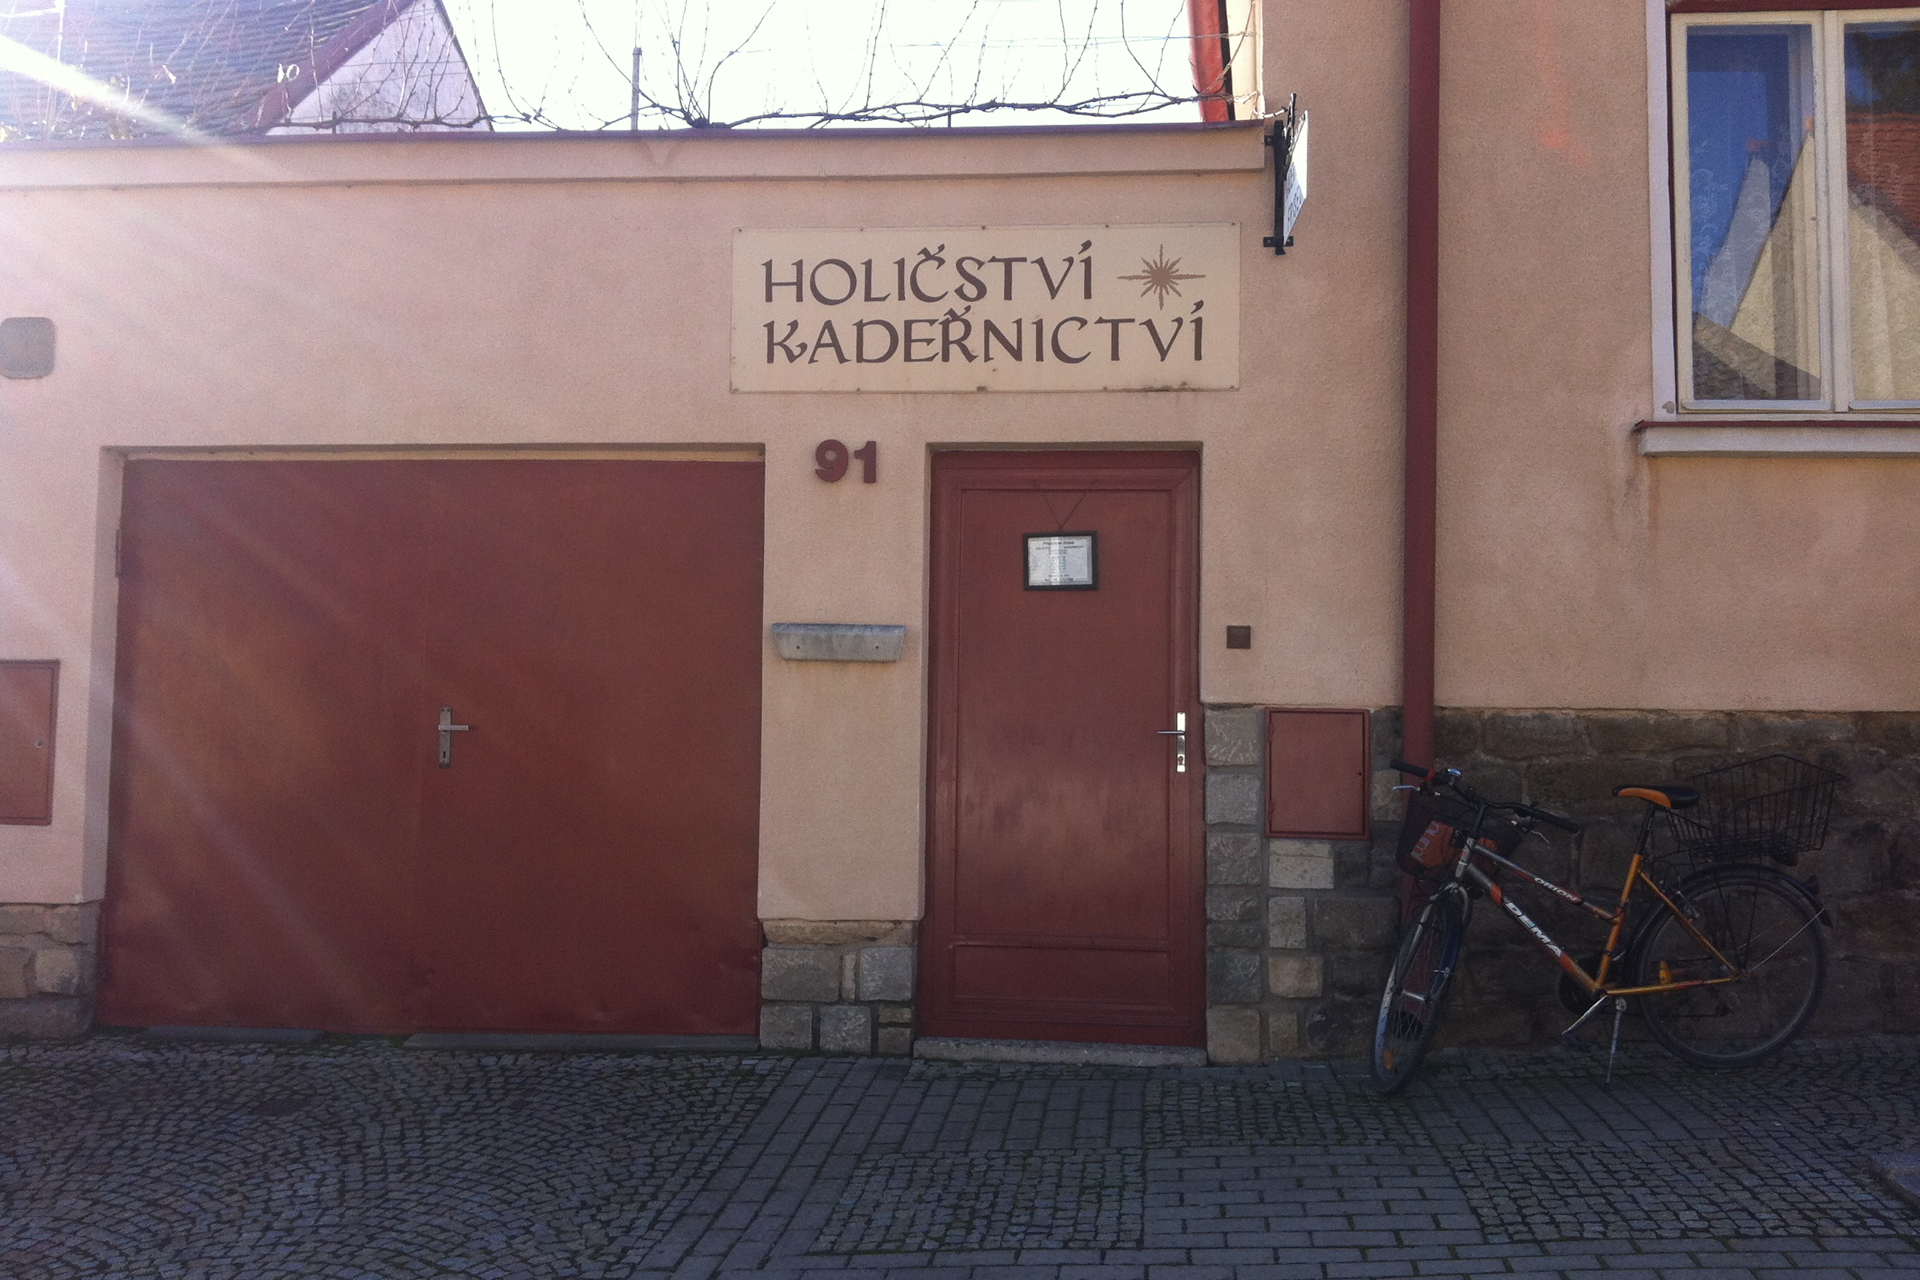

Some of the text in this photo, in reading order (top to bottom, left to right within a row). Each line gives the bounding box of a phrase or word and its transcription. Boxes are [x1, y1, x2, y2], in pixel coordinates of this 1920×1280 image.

[761, 240, 1093, 306] HOLIČSTVÍ
[763, 300, 1204, 364] KADEŘNICTVÍ
[815, 438, 877, 483] 91
[1534, 877, 1580, 902] ORION
[1505, 902, 1562, 957] DEMA
